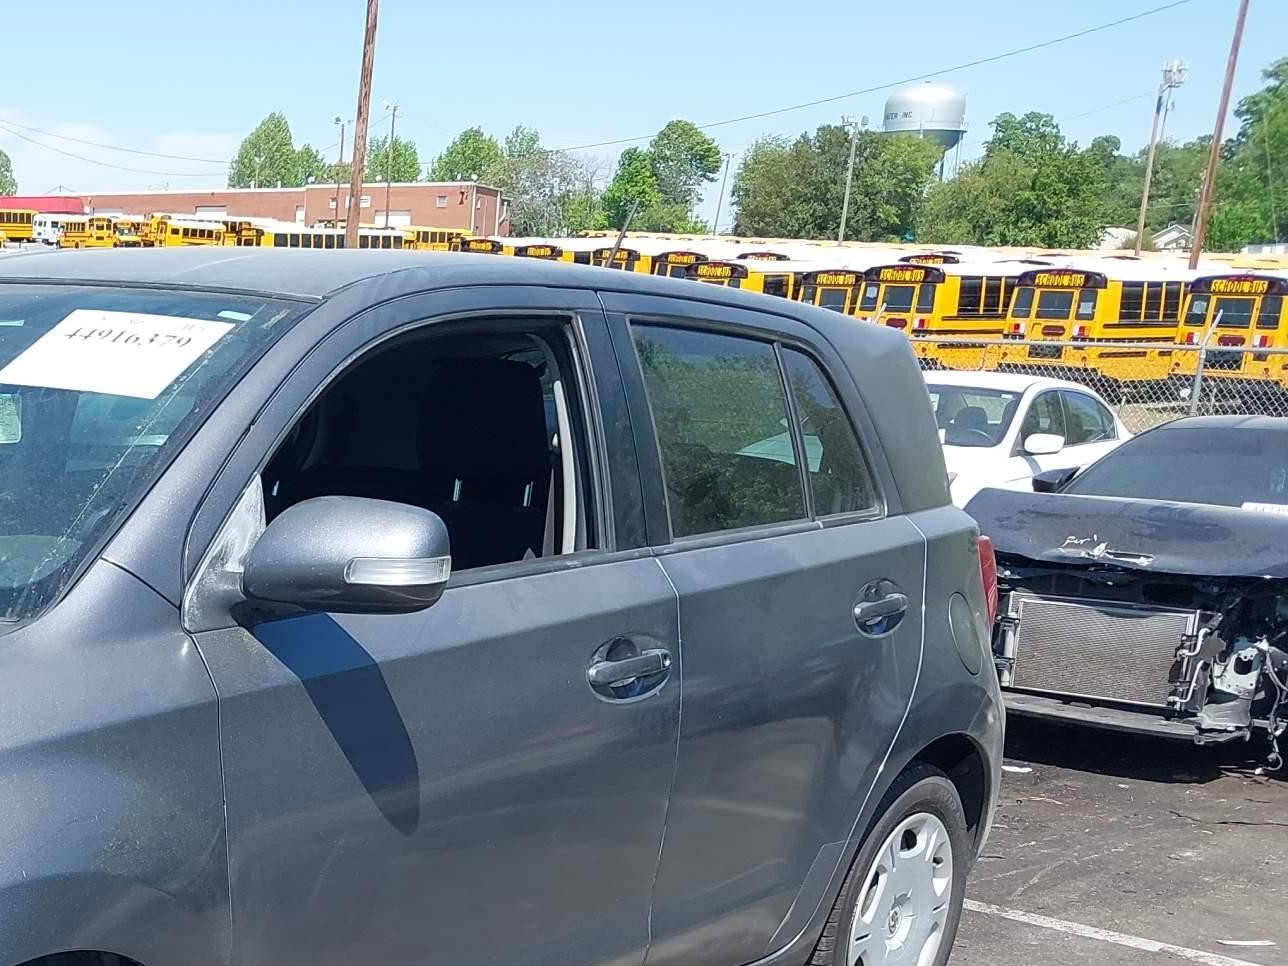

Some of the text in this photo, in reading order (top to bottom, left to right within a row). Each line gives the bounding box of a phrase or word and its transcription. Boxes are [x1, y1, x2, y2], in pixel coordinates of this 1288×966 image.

[881, 270, 924, 282] SCHOOL BUS
[1036, 275, 1083, 286] SCHOOL BUS
[1213, 281, 1266, 293] SCHOOL BUS
